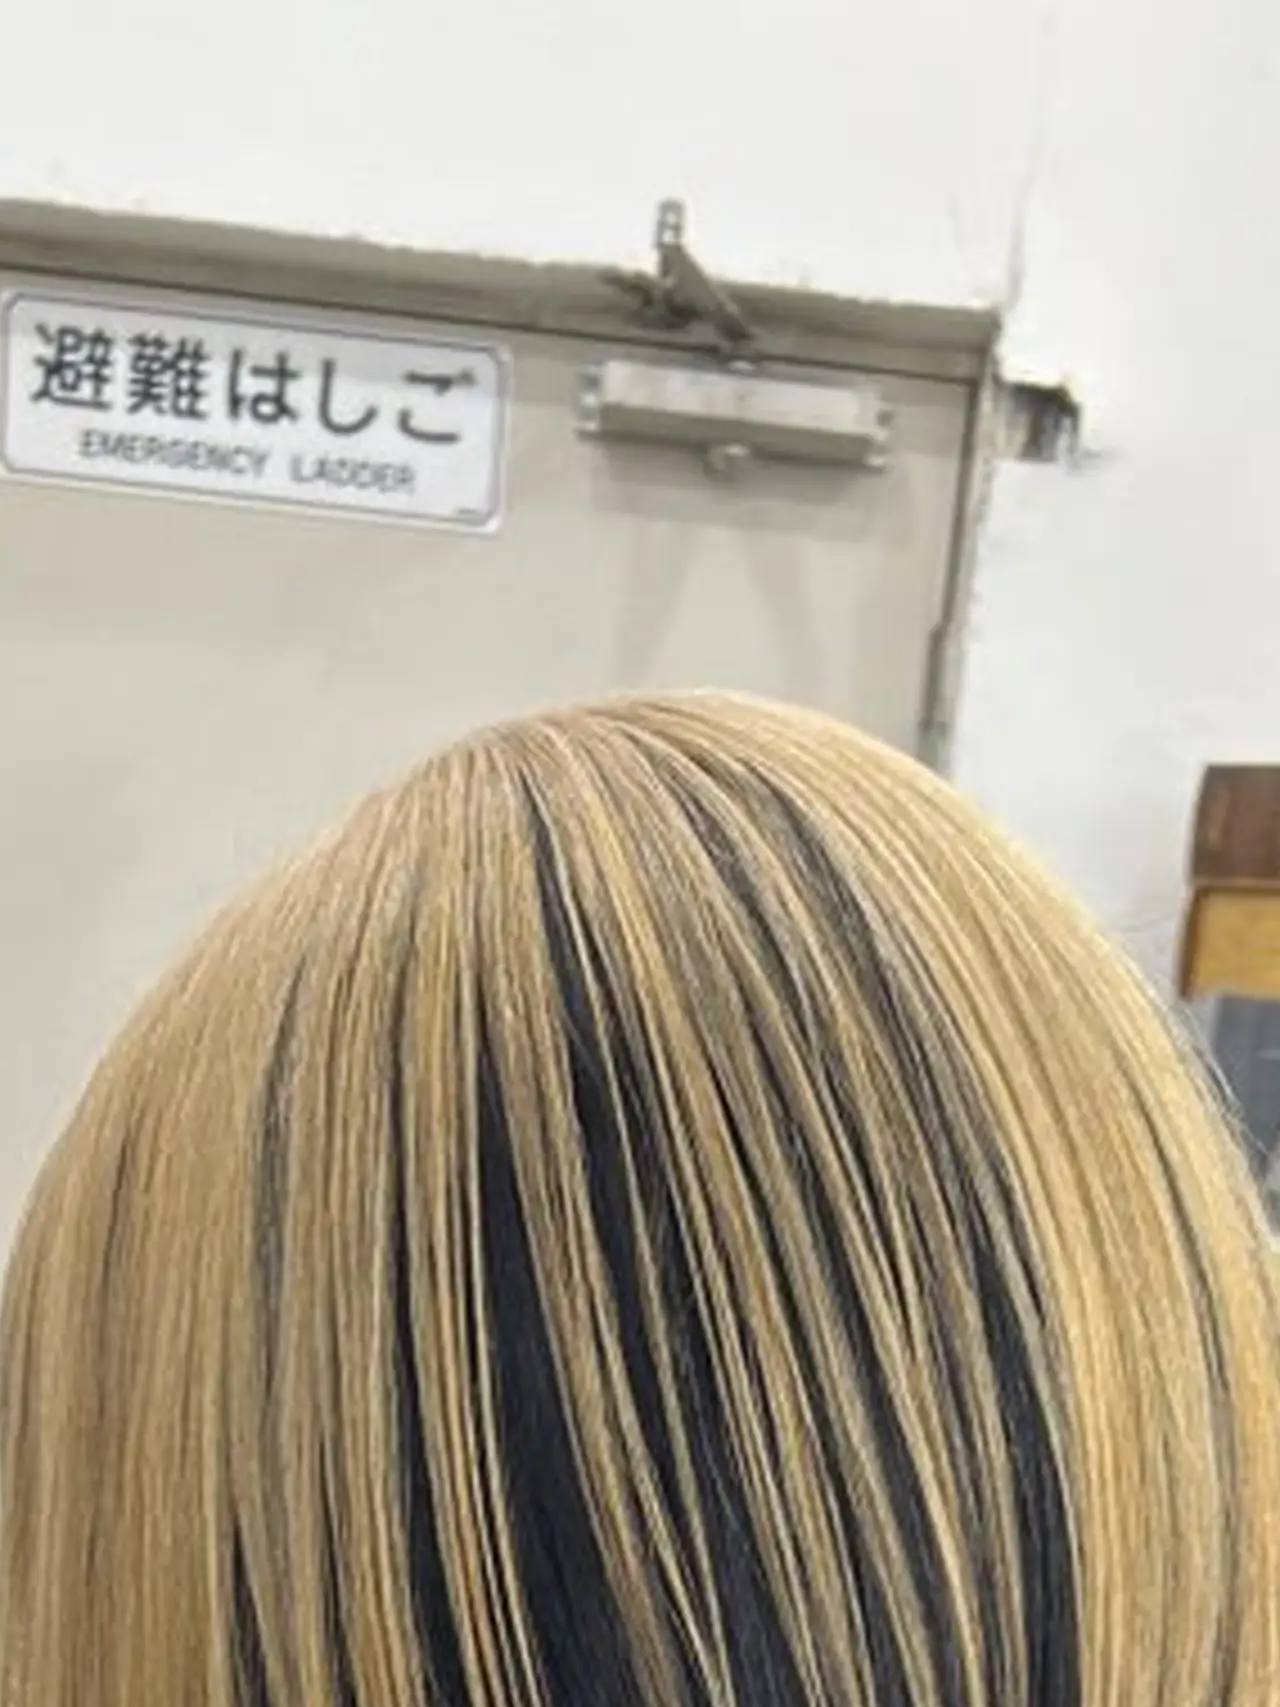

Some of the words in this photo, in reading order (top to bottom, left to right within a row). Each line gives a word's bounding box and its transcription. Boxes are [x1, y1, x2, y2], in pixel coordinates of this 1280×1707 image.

[29, 322, 477, 445] 避難はしご
[78, 429, 271, 479] EMERGENCY
[289, 454, 416, 495] LADDER
